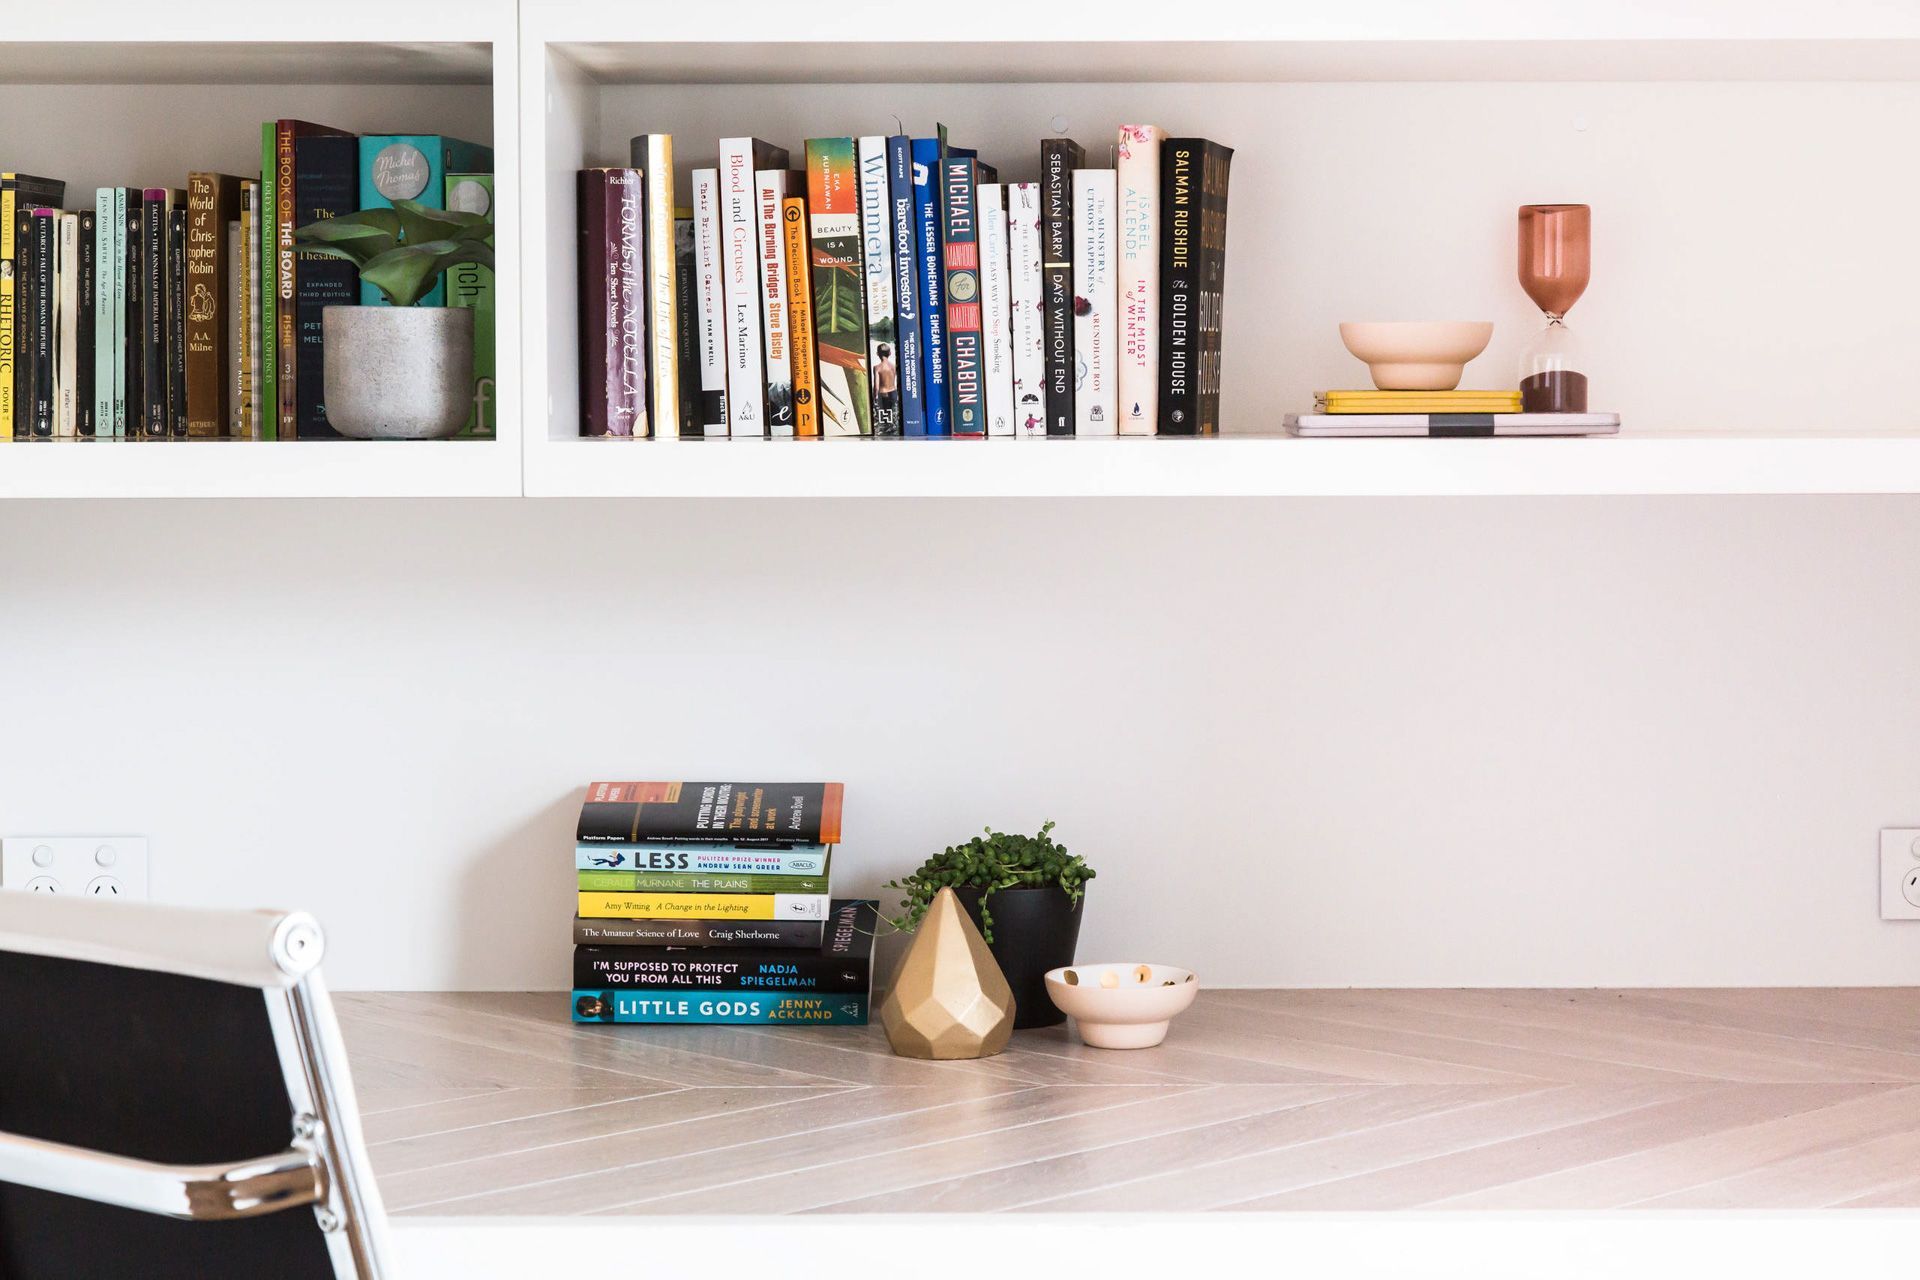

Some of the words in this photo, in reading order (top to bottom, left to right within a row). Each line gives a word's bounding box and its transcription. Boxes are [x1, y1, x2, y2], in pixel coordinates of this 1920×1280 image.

[280, 130, 291, 153] THE
[376, 151, 419, 173] Michel
[730, 154, 745, 193] Blood
[192, 180, 210, 193] The
[281, 157, 292, 194] BOOK
[376, 169, 421, 189] Thomas
[823, 155, 833, 210] KURNIAWAN
[1050, 153, 1062, 217] SEBASTIAN
[1174, 150, 1190, 205] SALMAN
[189, 196, 214, 210] World
[700, 182, 709, 211] Their
[762, 188, 774, 200] All
[949, 164, 970, 236] MICHAEL
[194, 213, 207, 226] of
[281, 200, 292, 217] OF
[313, 208, 336, 219] The
[732, 197, 746, 222] and
[764, 204, 776, 220] The
[864, 152, 886, 276] Wimmera
[924, 202, 934, 218] THE
[1087, 187, 1095, 232] UTMOST
[190, 229, 216, 242] Chris-
[281, 222, 292, 245] THE
[620, 194, 637, 259] FORMS
[817, 226, 852, 235] BEAUTY
[896, 197, 912, 254] barefoot
[1126, 187, 1136, 260] ALLENDE
[1138, 196, 1150, 250] ISABEL
[702, 216, 712, 267] Brilliant
[764, 222, 778, 259] Burning
[925, 221, 934, 252] LESSER
[1052, 222, 1062, 258] BARRY
[1174, 210, 1188, 269] RUSHDIE
[189, 261, 214, 274] Robin
[610, 260, 618, 275] Ten
[619, 261, 637, 274] of
[733, 226, 747, 284] Circuses
[792, 242, 800, 276] Decision
[820, 256, 854, 264] WOUND
[1088, 236, 1096, 294] HAPPINESS
[40, 274, 47, 283] OF
[154, 280, 160, 290] OF
[282, 250, 292, 299] BOARD
[766, 262, 780, 298] Bridges
[793, 278, 801, 297] Book
[899, 256, 914, 311] investor
[928, 256, 939, 306] BOHEMIANS
[1096, 276, 1105, 285] of
[1138, 280, 1146, 293] IN
[1172, 280, 1189, 288] The
[610, 277, 619, 299] Short
[621, 276, 639, 303] the
[705, 273, 713, 314] Careers
[1053, 274, 1064, 304] DAYS
[1126, 292, 1136, 301] of
[611, 302, 619, 328] Novels
[737, 304, 748, 323] Lex
[770, 302, 782, 329] Steve
[1138, 299, 1146, 322] THE
[1172, 294, 1187, 346] GOLDEN
[0, 293, 12, 372] RHETORIC
[282, 314, 292, 349] FISHEL
[930, 314, 940, 346] EIMEAR
[1054, 308, 1065, 364] WITHOUT
[1128, 304, 1136, 356] WINTER
[189, 344, 213, 353] Milne
[738, 327, 751, 369] Marinos
[771, 332, 784, 360] Bisley
[1138, 328, 1146, 368] MIDST
[932, 348, 942, 384] McBRIDE
[955, 336, 978, 404] CHABON
[1172, 351, 1186, 395] HOUSE
[1055, 369, 1066, 394] END
[634, 852, 689, 870] LESS
[636, 878, 684, 888] MURNANE
[692, 879, 710, 888] THE
[714, 880, 748, 889] PLAINS
[604, 901, 622, 912] Amy
[624, 901, 651, 912] Witting
[656, 902, 662, 911] A
[664, 902, 692, 913] Change
[694, 903, 702, 912] in
[704, 902, 714, 912] the
[716, 902, 749, 914] Lighting
[582, 928, 600, 938] The
[601, 928, 634, 938] Amateur
[636, 929, 664, 938] Science
[666, 929, 676, 939] of
[678, 930, 700, 940] Love
[708, 930, 734, 941] Craig
[735, 930, 780, 940] Sherborne
[832, 906, 858, 952] SPIEGELMAN
[594, 962, 610, 970] I'M
[614, 962, 669, 972] SUPPOSED
[672, 963, 686, 972] TO
[690, 964, 739, 972] PROTECT
[606, 974, 628, 982] YOU
[634, 974, 668, 983] FROM
[672, 975, 692, 984] ALL
[696, 976, 722, 984] THIS
[760, 964, 798, 974] NADJA
[740, 976, 816, 986] SPIEGELMAN
[619, 1000, 688, 1015] LITTLE
[699, 1002, 760, 1016] GODS
[768, 1010, 833, 1019] ACKLAND
[779, 1000, 823, 1008] JENNY
